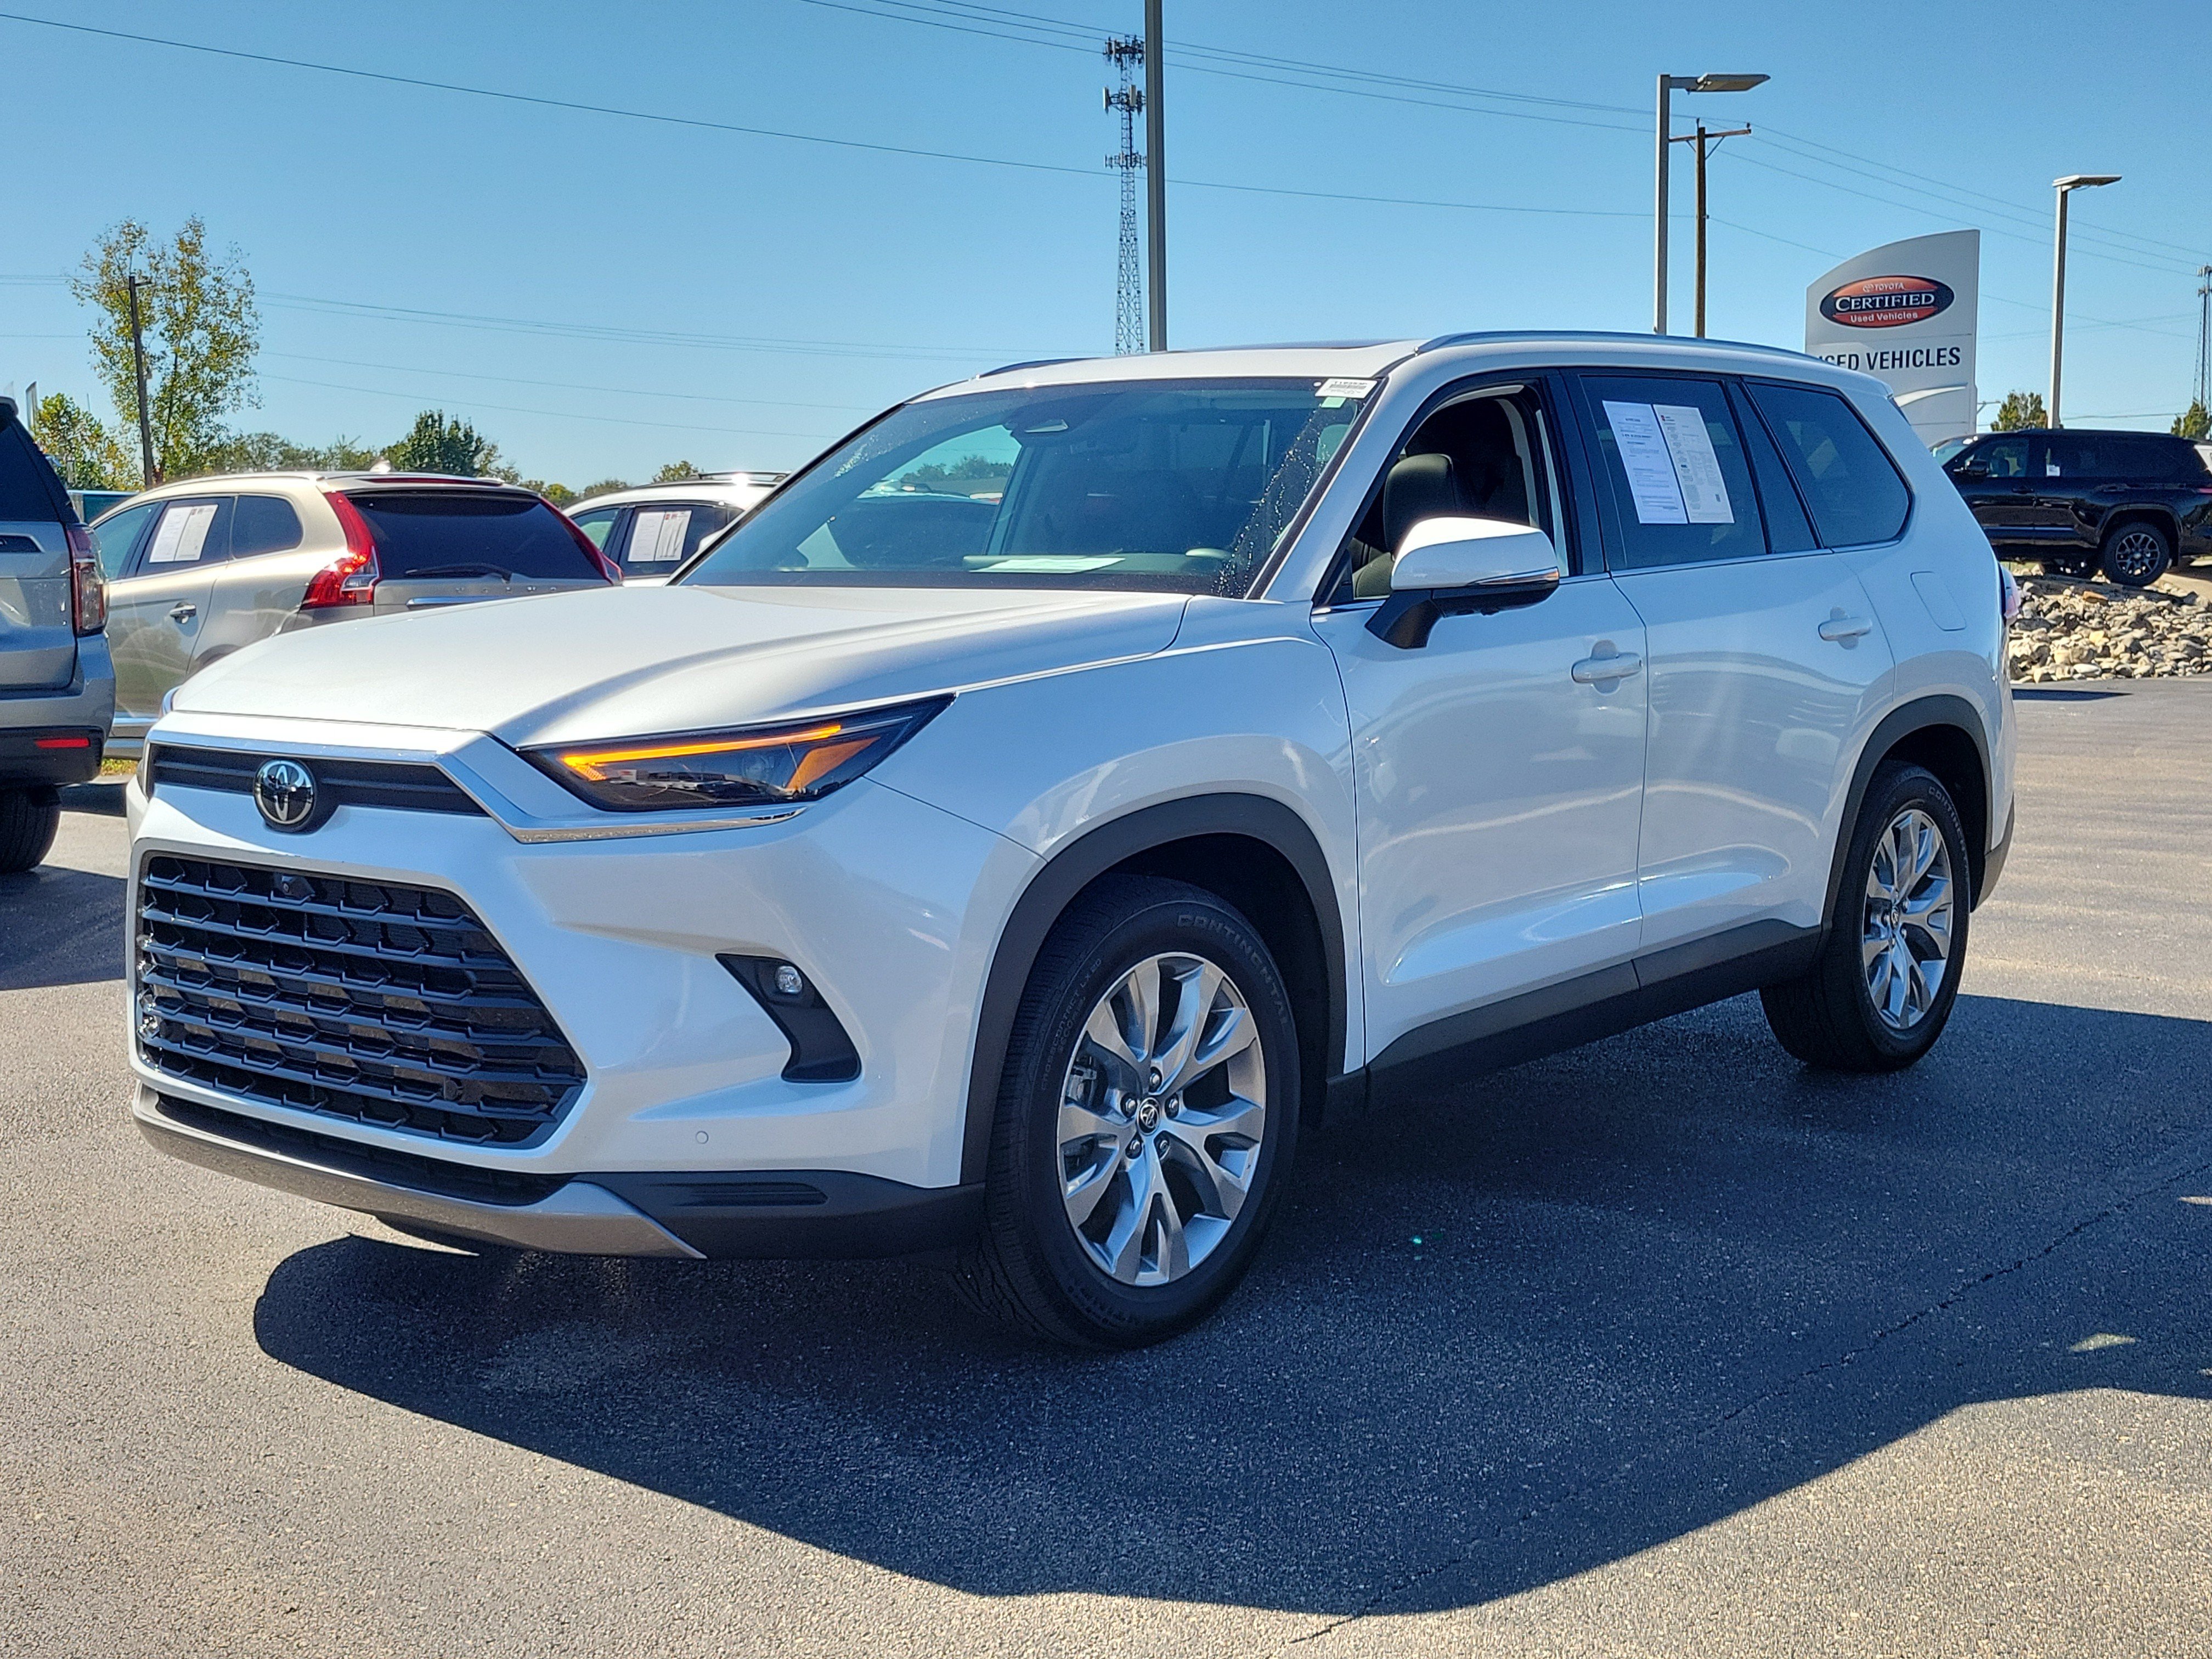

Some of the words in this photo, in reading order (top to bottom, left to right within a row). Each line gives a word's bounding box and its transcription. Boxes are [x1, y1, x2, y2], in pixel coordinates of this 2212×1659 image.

[1875, 282, 1904, 291] TOYOTA
[1836, 293, 1934, 311] CERTIFIED
[1850, 315, 1875, 323] Used
[1876, 312, 1918, 321] Vehicles
[1819, 353, 1859, 371] ED
[1866, 346, 1961, 370] VEHICLES
